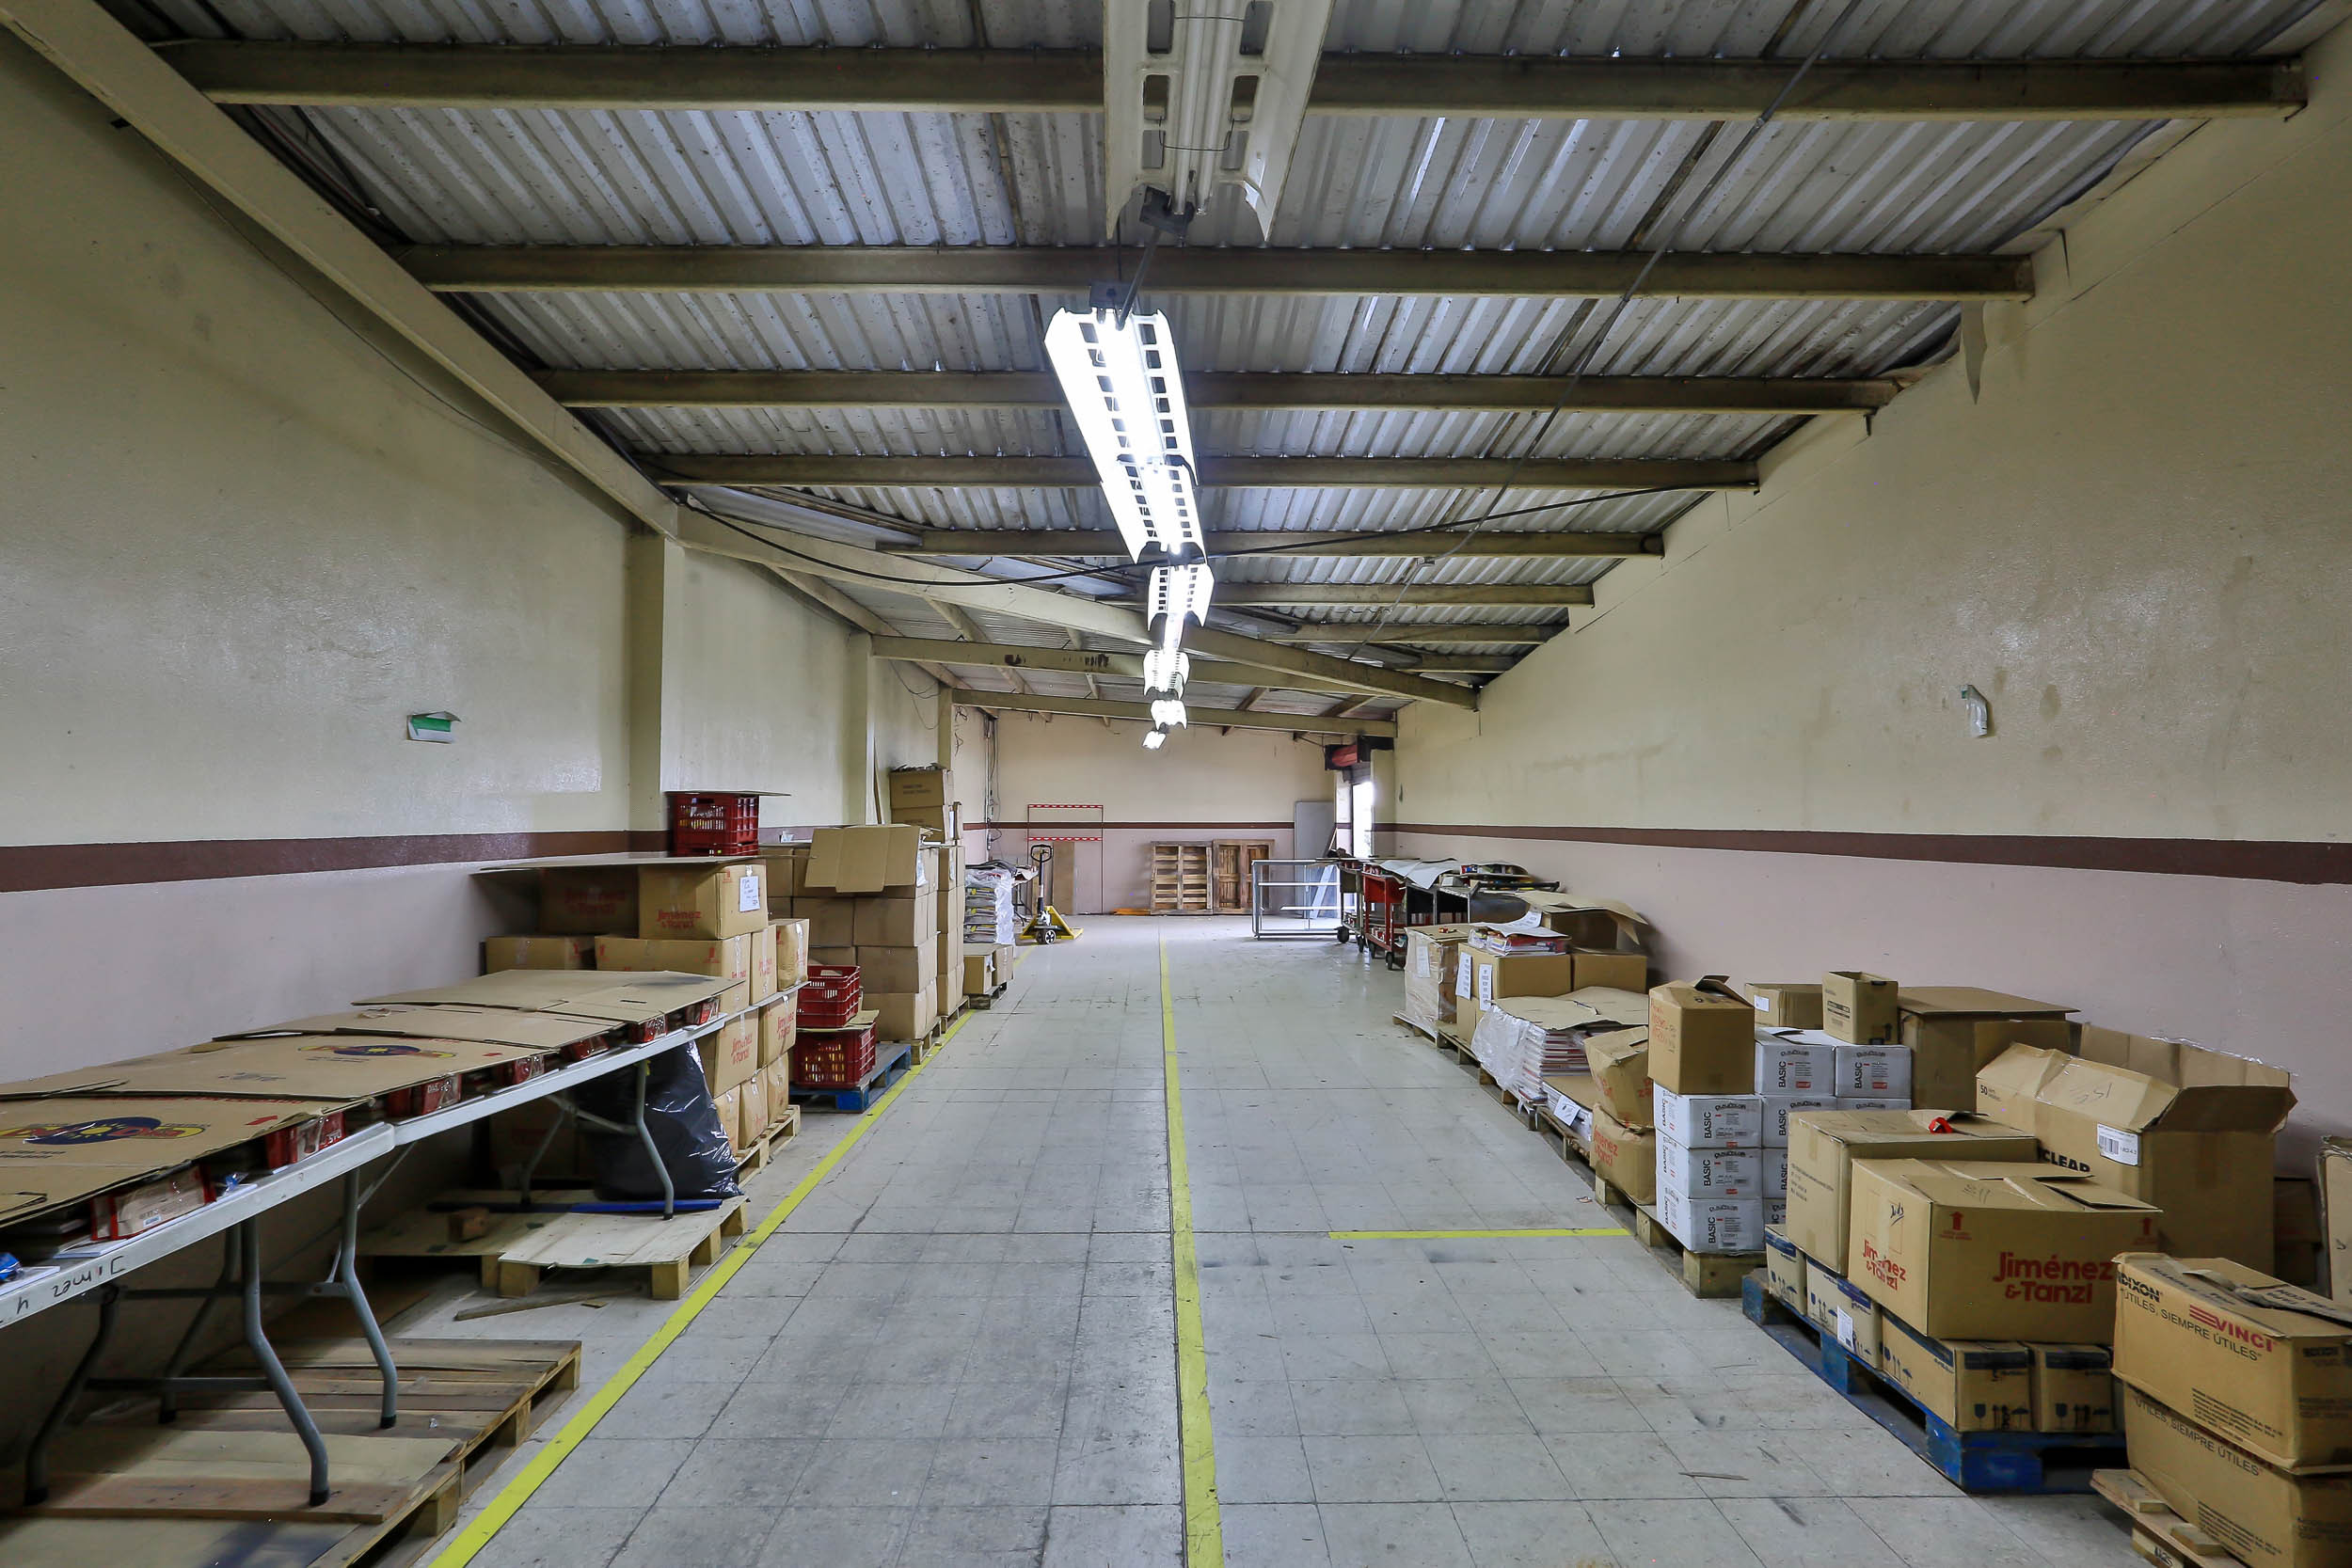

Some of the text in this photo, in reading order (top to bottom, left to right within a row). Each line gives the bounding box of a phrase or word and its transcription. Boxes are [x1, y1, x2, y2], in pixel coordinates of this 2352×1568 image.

[1778, 1061, 1787, 1088] BASIC
[1854, 1062, 1863, 1089] BASIC
[1979, 1084, 1988, 1096] 50
[1704, 1111, 1712, 1139] BASIC
[1778, 1109, 1787, 1136] BASIC
[1703, 1159, 1711, 1187] BASIC
[1708, 1216, 1717, 1244] BASIC
[1993, 1251, 2115, 1283] Jiménez
[2118, 1271, 2161, 1303] DIXON
[2161, 1308, 2210, 1340] SIEMPRE
[2170, 1418, 2215, 1453] SIEMPRE
